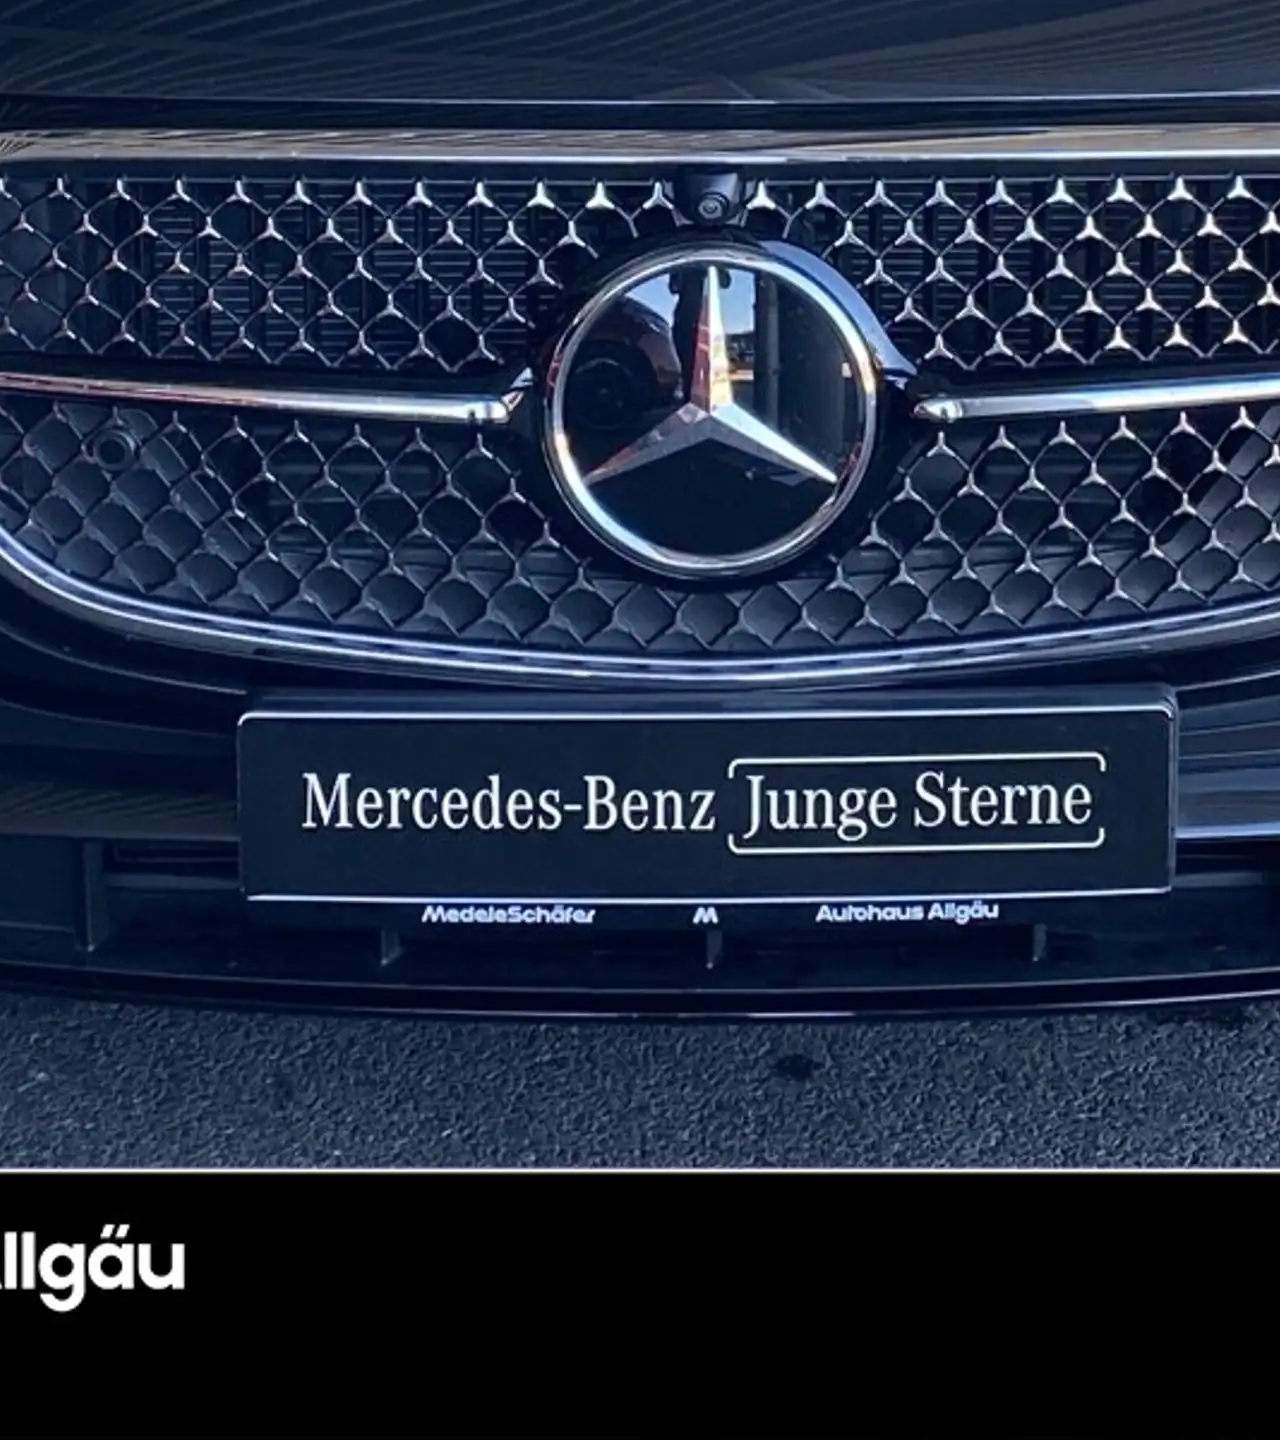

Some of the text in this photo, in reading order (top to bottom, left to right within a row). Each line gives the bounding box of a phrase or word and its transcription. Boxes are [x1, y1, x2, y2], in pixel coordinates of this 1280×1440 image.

[301, 770, 1093, 841] Mercedes-Benz Junge Sterne
[421, 903, 597, 925] MedeleSchäfer
[815, 898, 1000, 926] Autohaus Allgäu
